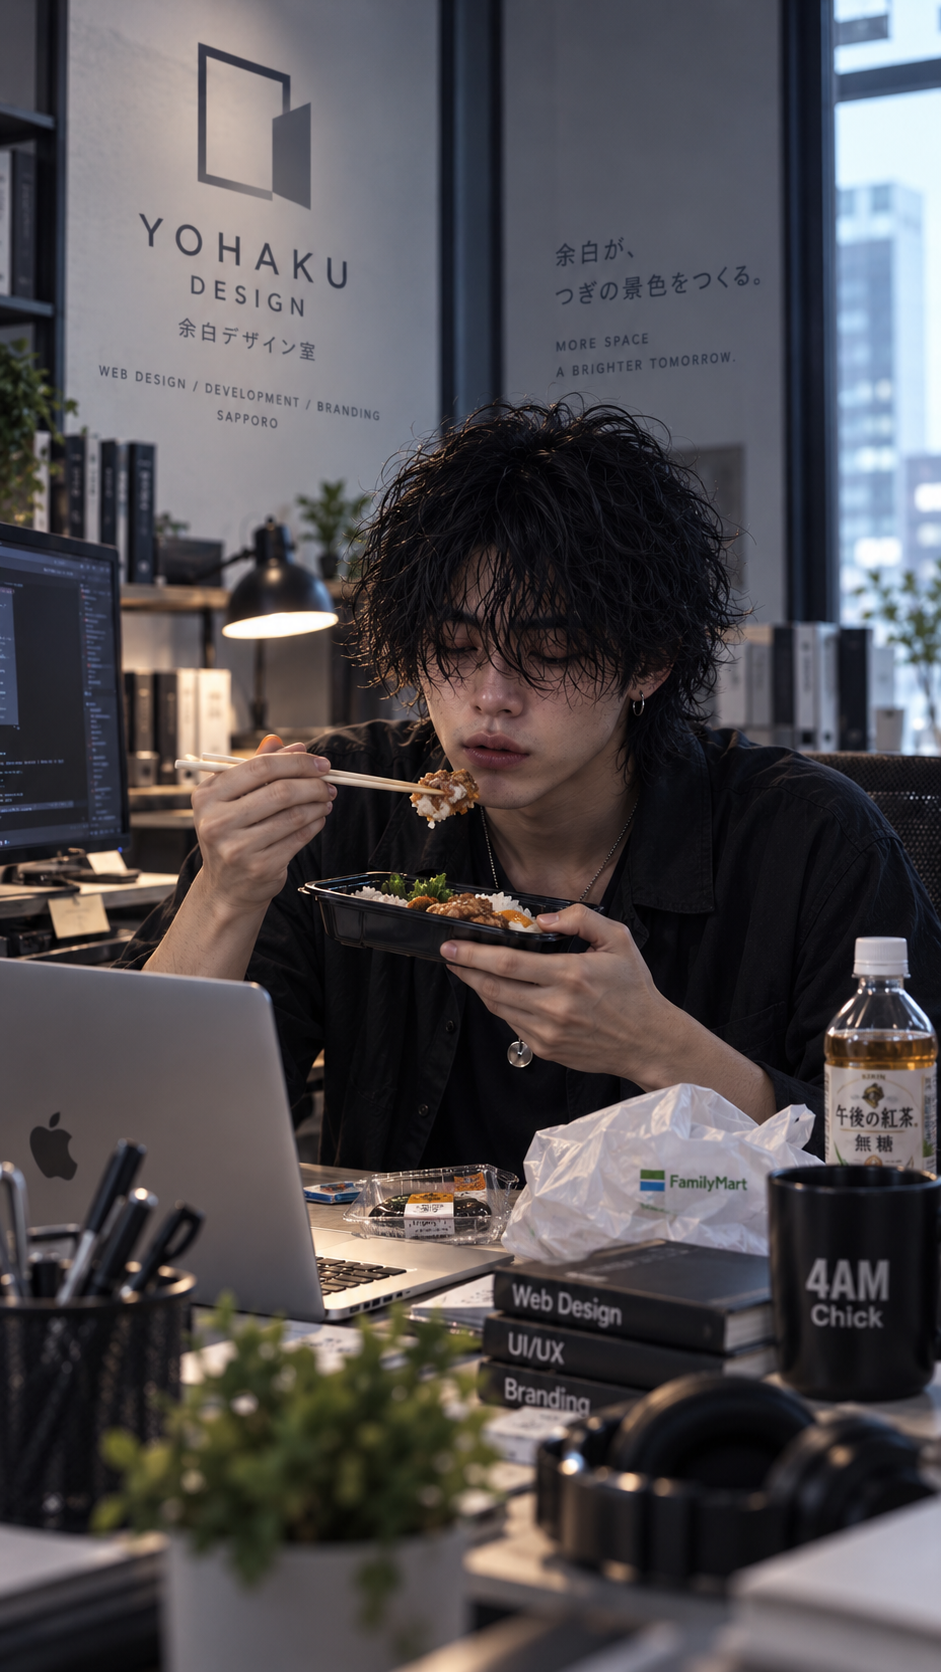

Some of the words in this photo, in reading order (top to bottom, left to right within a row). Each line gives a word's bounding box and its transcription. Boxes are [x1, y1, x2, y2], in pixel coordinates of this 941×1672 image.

[139, 213, 348, 289] YOHAKU
[555, 237, 634, 267] 余白が、
[190, 275, 305, 317] DESIGN
[555, 265, 761, 305] つぎの景色をつくる。
[178, 317, 316, 361] 余白デザイン室
[556, 338, 597, 352] MORE
[604, 333, 649, 348] SPACE
[556, 367, 565, 378] A
[572, 359, 643, 377] BRIGHTER
[649, 351, 737, 369] TOMORROW.
[98, 365, 128, 380] WEB
[135, 371, 186, 389] DESIGN
[205, 382, 300, 408] DEVELOPMENT
[317, 400, 381, 421] BRANDING
[217, 409, 279, 429] SAPPORO
[855, 1133, 894, 1153] 無糖
[669, 1174, 748, 1193] FamilyMart
[805, 1257, 890, 1302] 4AM
[511, 1282, 554, 1312] Web
[557, 1291, 623, 1329] Design
[810, 1303, 885, 1329] Chick
[507, 1331, 566, 1366] UI/UX
[504, 1376, 591, 1419] Branding
